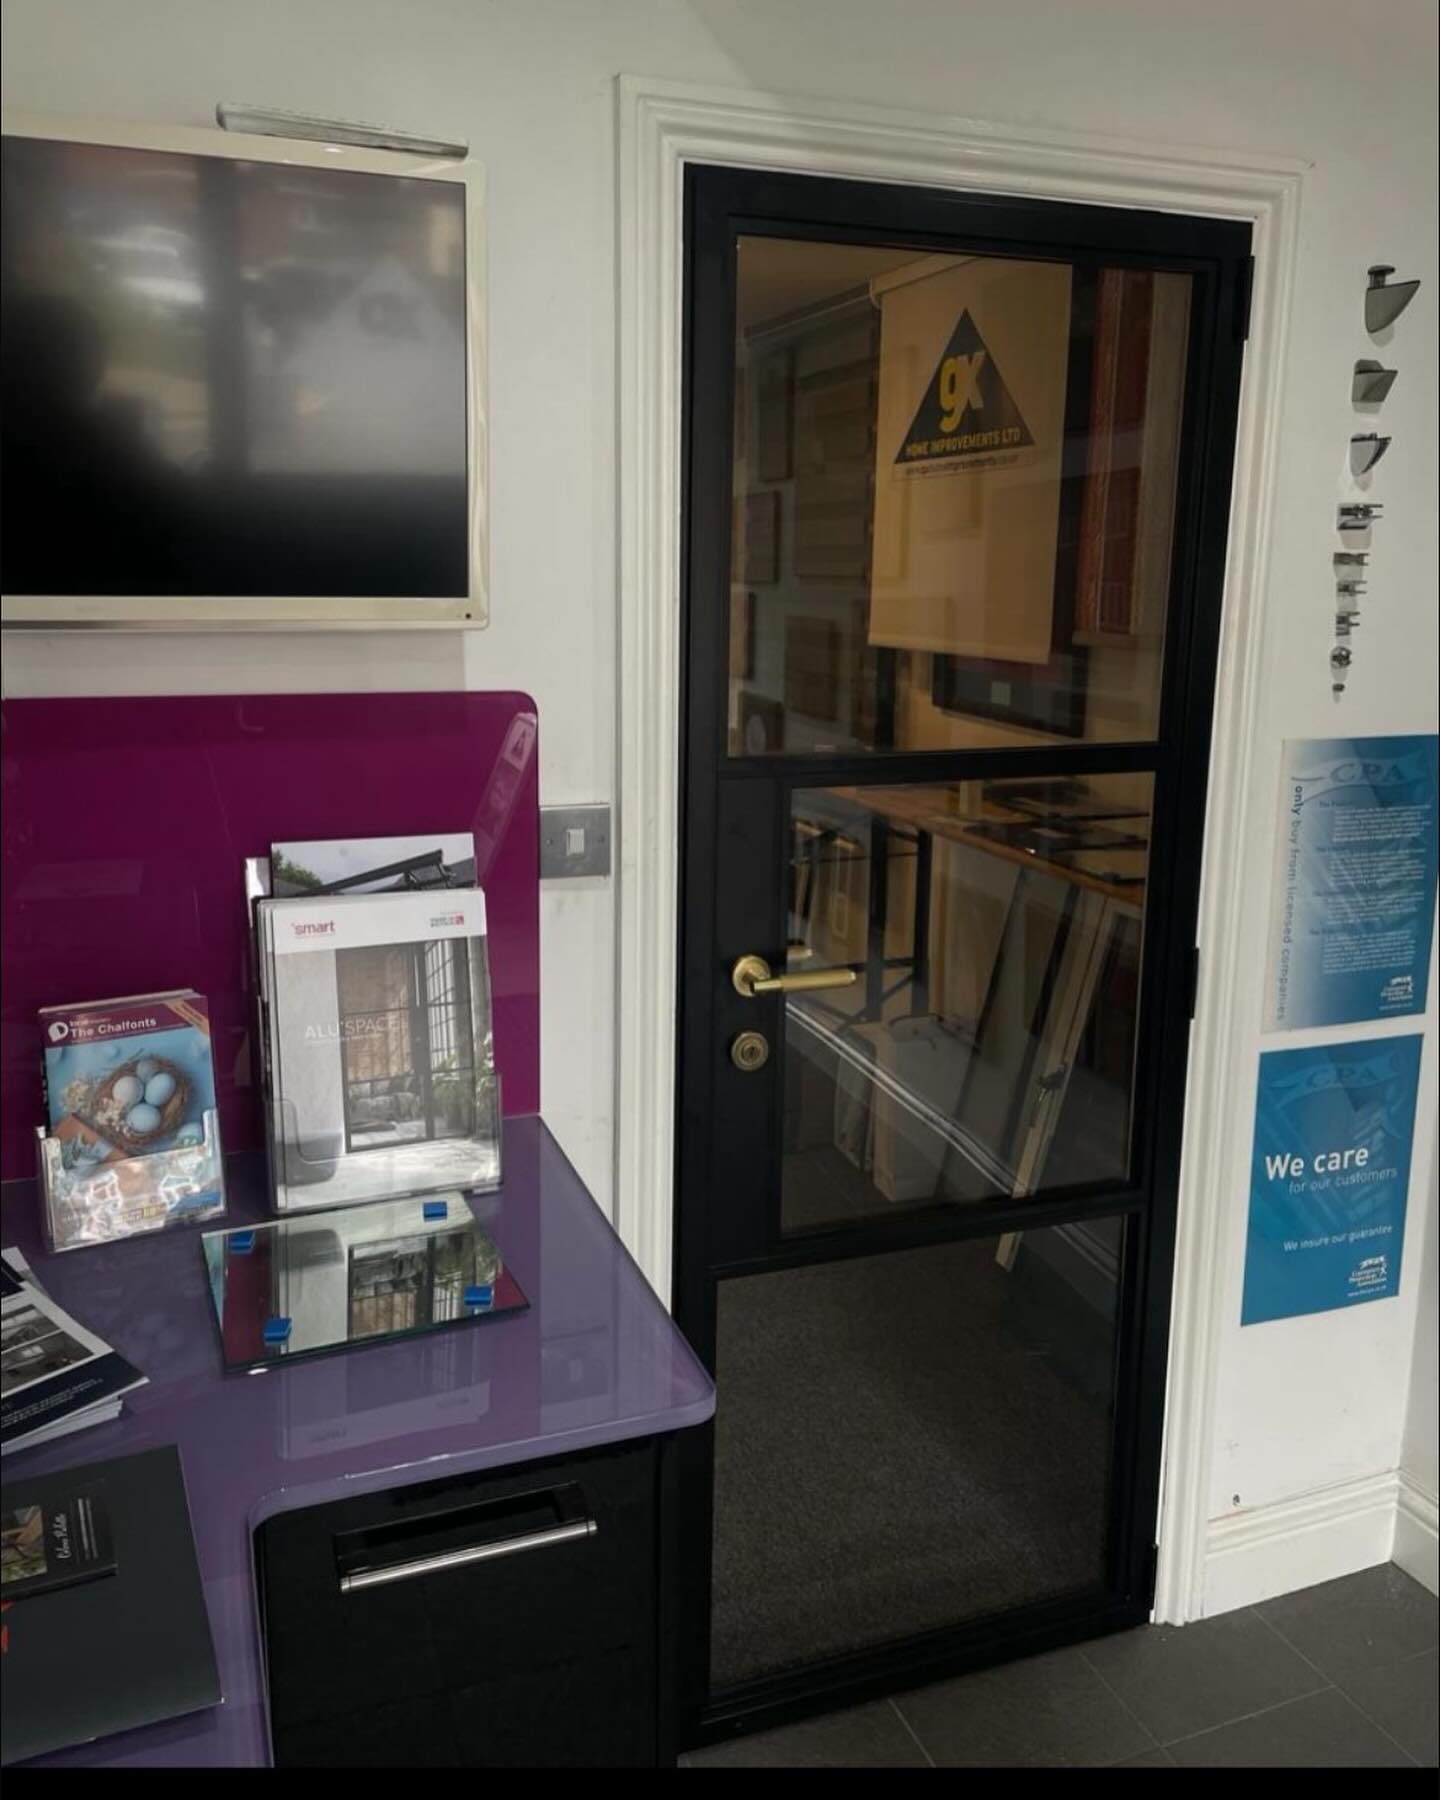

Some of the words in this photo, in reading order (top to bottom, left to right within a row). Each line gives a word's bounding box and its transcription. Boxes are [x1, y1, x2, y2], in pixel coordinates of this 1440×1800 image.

[931, 432, 999, 450] IMPROVEMENTS
[1002, 427, 1021, 443] LTD
[1330, 763, 1406, 783] CPA
[1291, 785, 1304, 815] only
[1288, 820, 1301, 843] buy
[1287, 848, 1300, 880] from
[1283, 886, 1297, 943] licensed
[1277, 948, 1290, 1021] companies
[70, 1027, 94, 1039] The
[98, 1018, 157, 1035] Chalfonts
[1265, 1152, 1304, 1181] We
[1314, 1147, 1369, 1174] care
[1289, 1181, 1305, 1195] for
[1310, 1178, 1331, 1191] our
[1335, 1167, 1397, 1188] customers
[1284, 1240, 1298, 1252] We
[1300, 1236, 1329, 1250] insure
[1332, 1233, 1347, 1245] our
[1349, 1224, 1393, 1243] guarantee
